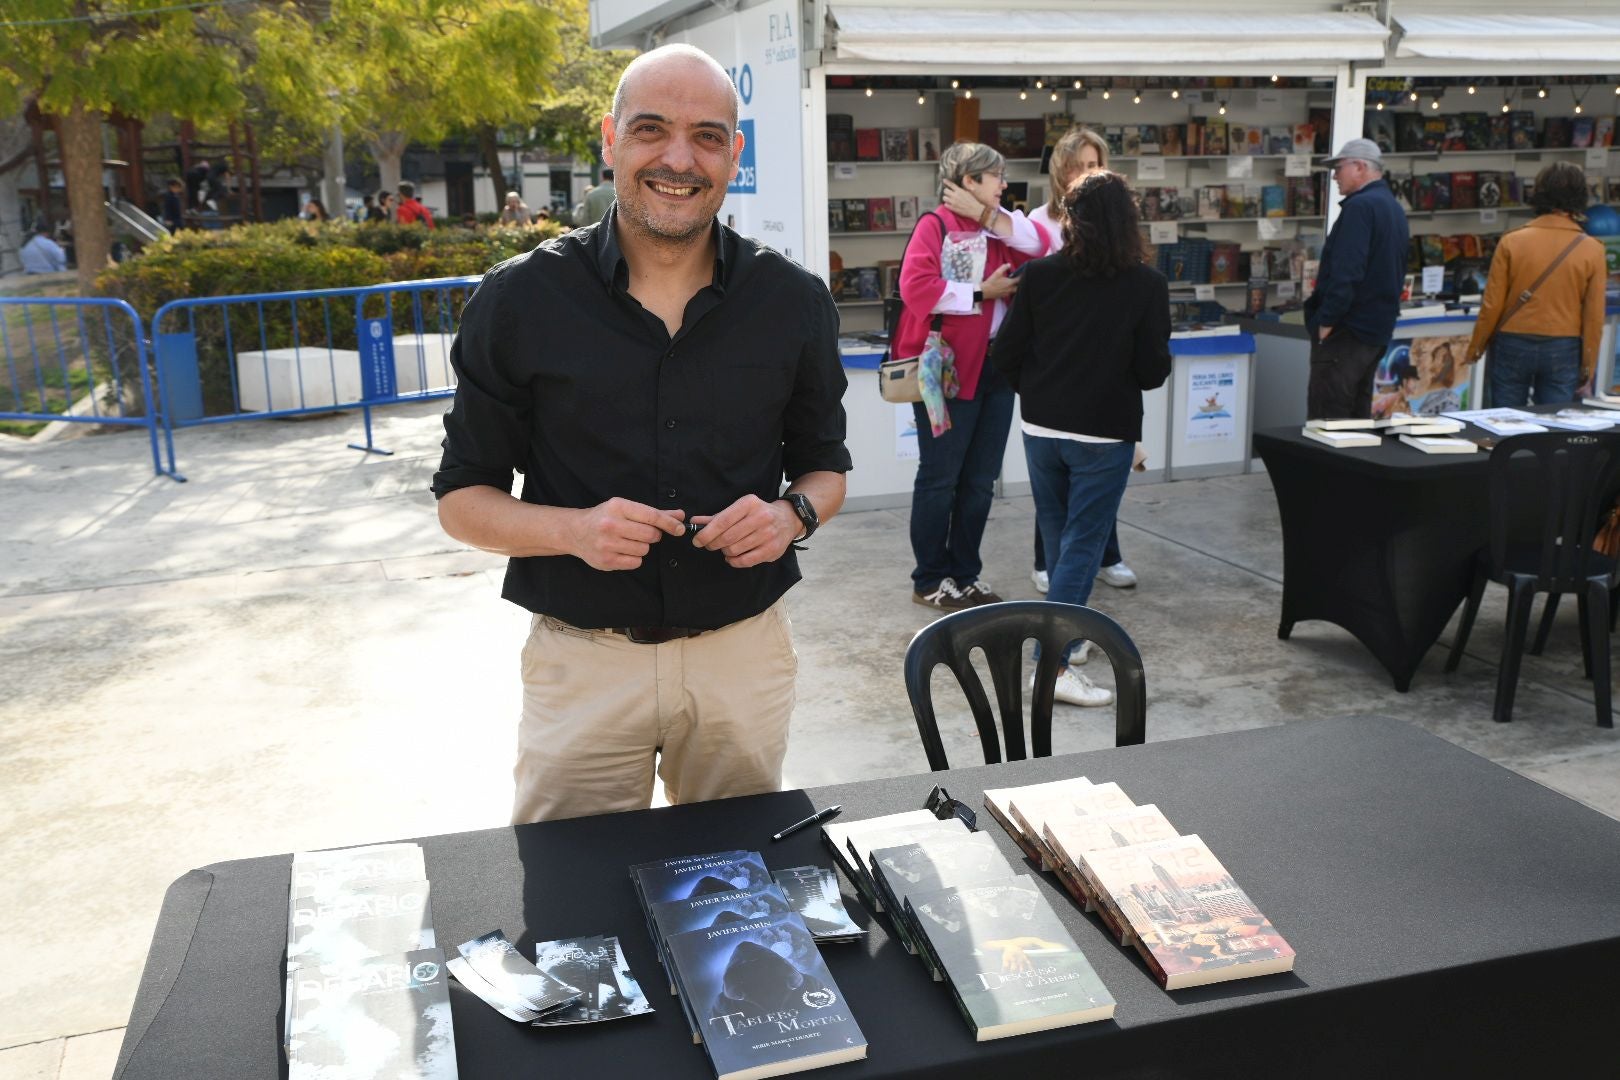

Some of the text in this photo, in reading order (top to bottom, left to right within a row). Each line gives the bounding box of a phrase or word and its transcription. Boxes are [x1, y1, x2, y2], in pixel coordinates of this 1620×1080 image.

[769, 12, 792, 42] FLA
[674, 864, 702, 875] JAVIER
[690, 897, 719, 909] JAVIER
[707, 927, 739, 939] JAVIER
[709, 1009, 799, 1039] TABLERO
[775, 1014, 847, 1034] MORTAL
[771, 1037, 794, 1045] MARCO
[795, 1032, 821, 1041] DUARTE
